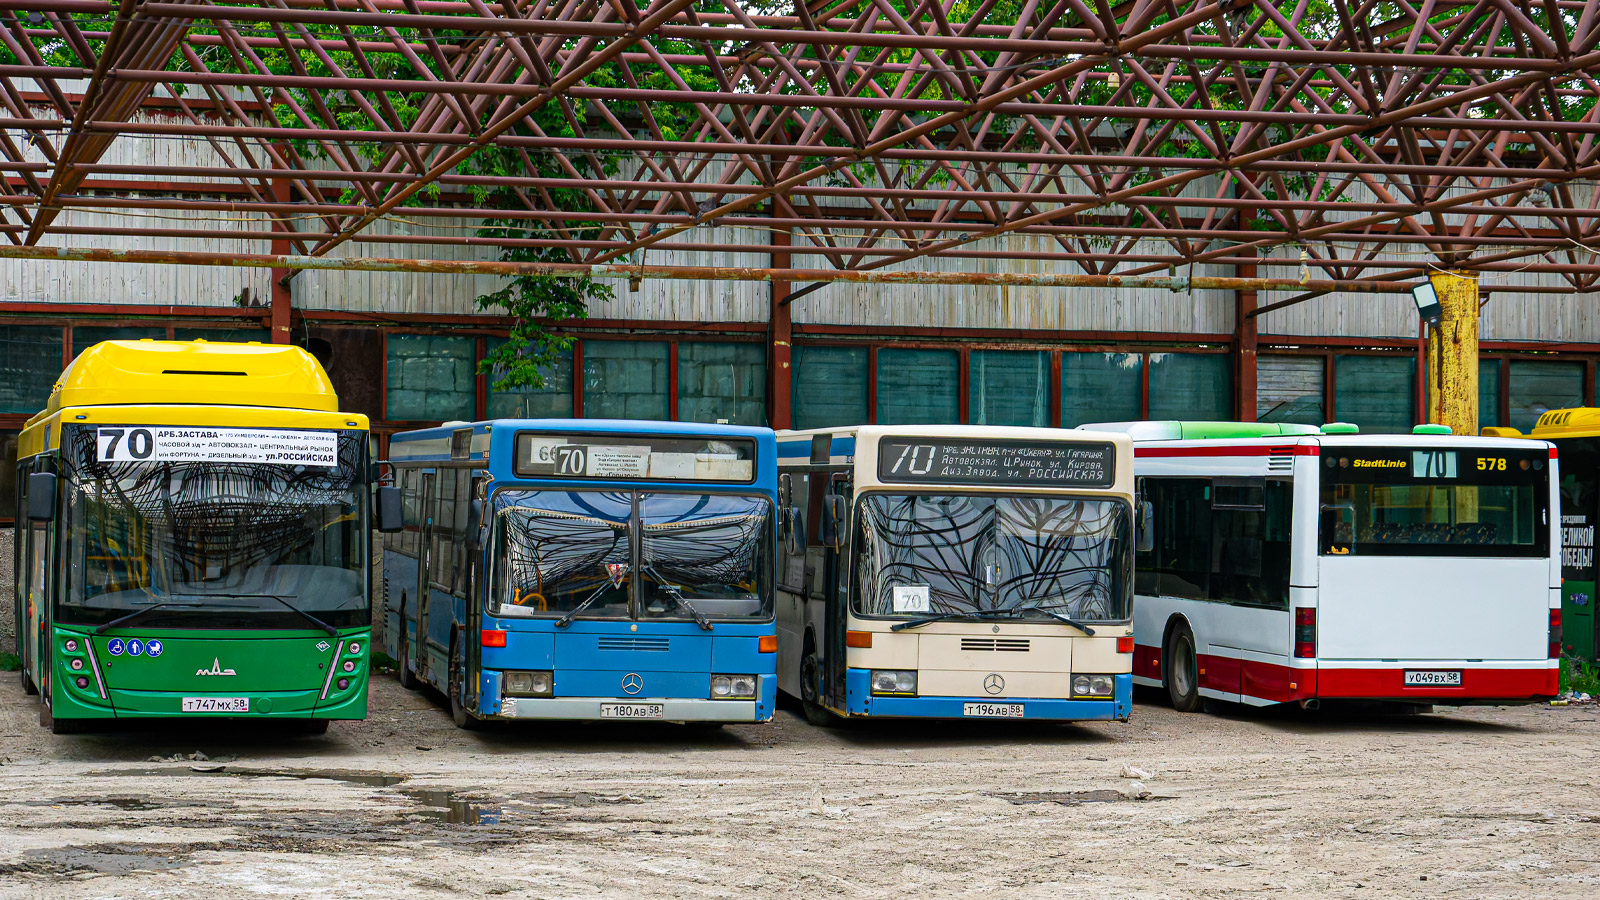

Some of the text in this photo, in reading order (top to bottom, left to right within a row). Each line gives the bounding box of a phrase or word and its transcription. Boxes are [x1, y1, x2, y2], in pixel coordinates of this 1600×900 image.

[99, 429, 153, 459] 70
[266, 452, 334, 462] ул.РОССИЙСКАЯ
[560, 450, 584, 474] 70
[891, 444, 936, 474] 70
[1353, 459, 1406, 468] StadtLinie
[1422, 451, 1446, 477] 70
[1476, 458, 1506, 470] 578
[1028, 468, 1104, 480] РОССИЙСКАЯ
[1562, 548, 1592, 570] ОБЕДЫ!
[902, 594, 922, 609] 70
